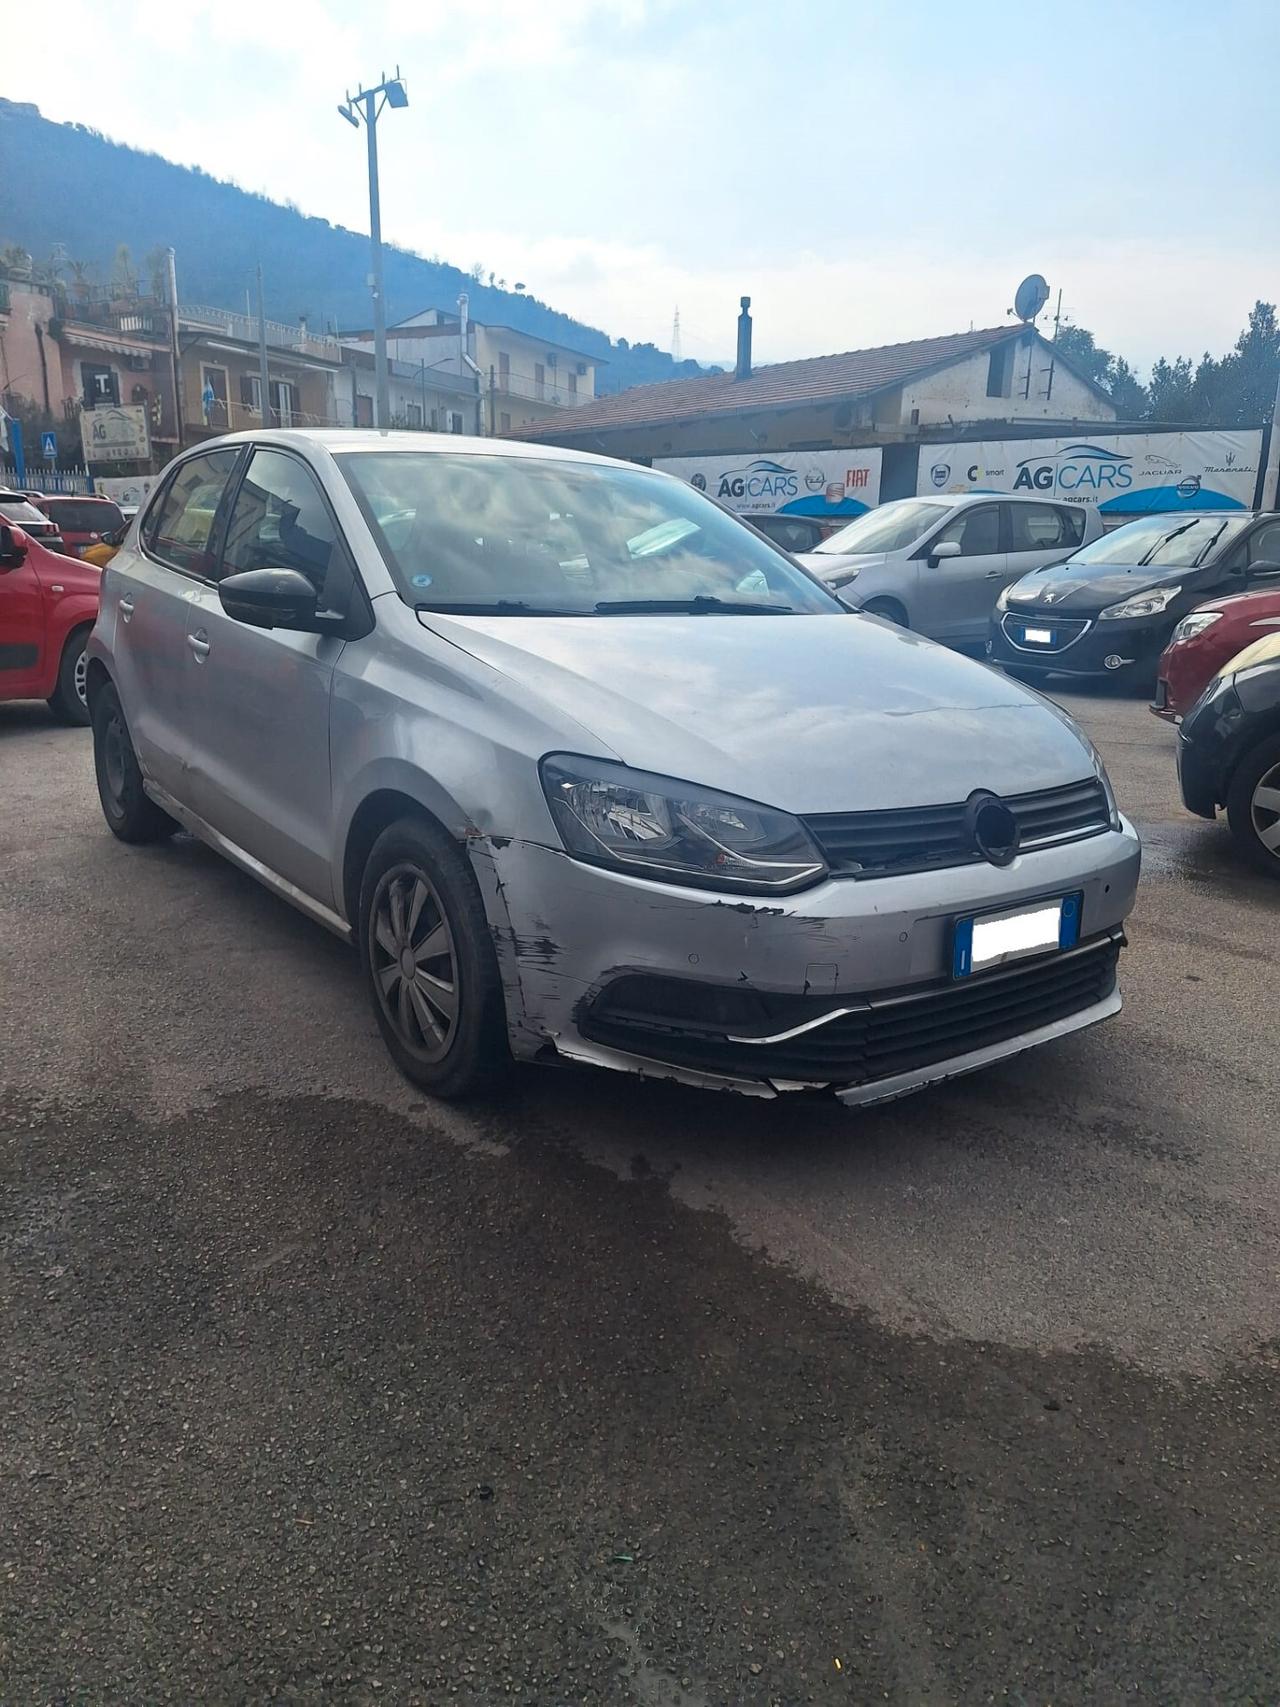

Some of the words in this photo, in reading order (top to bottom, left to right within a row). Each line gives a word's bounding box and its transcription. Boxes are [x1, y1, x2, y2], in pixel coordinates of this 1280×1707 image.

[747, 475, 798, 497] CARS
[846, 469, 870, 488] FIAT
[1057, 463, 1133, 489] CARS
